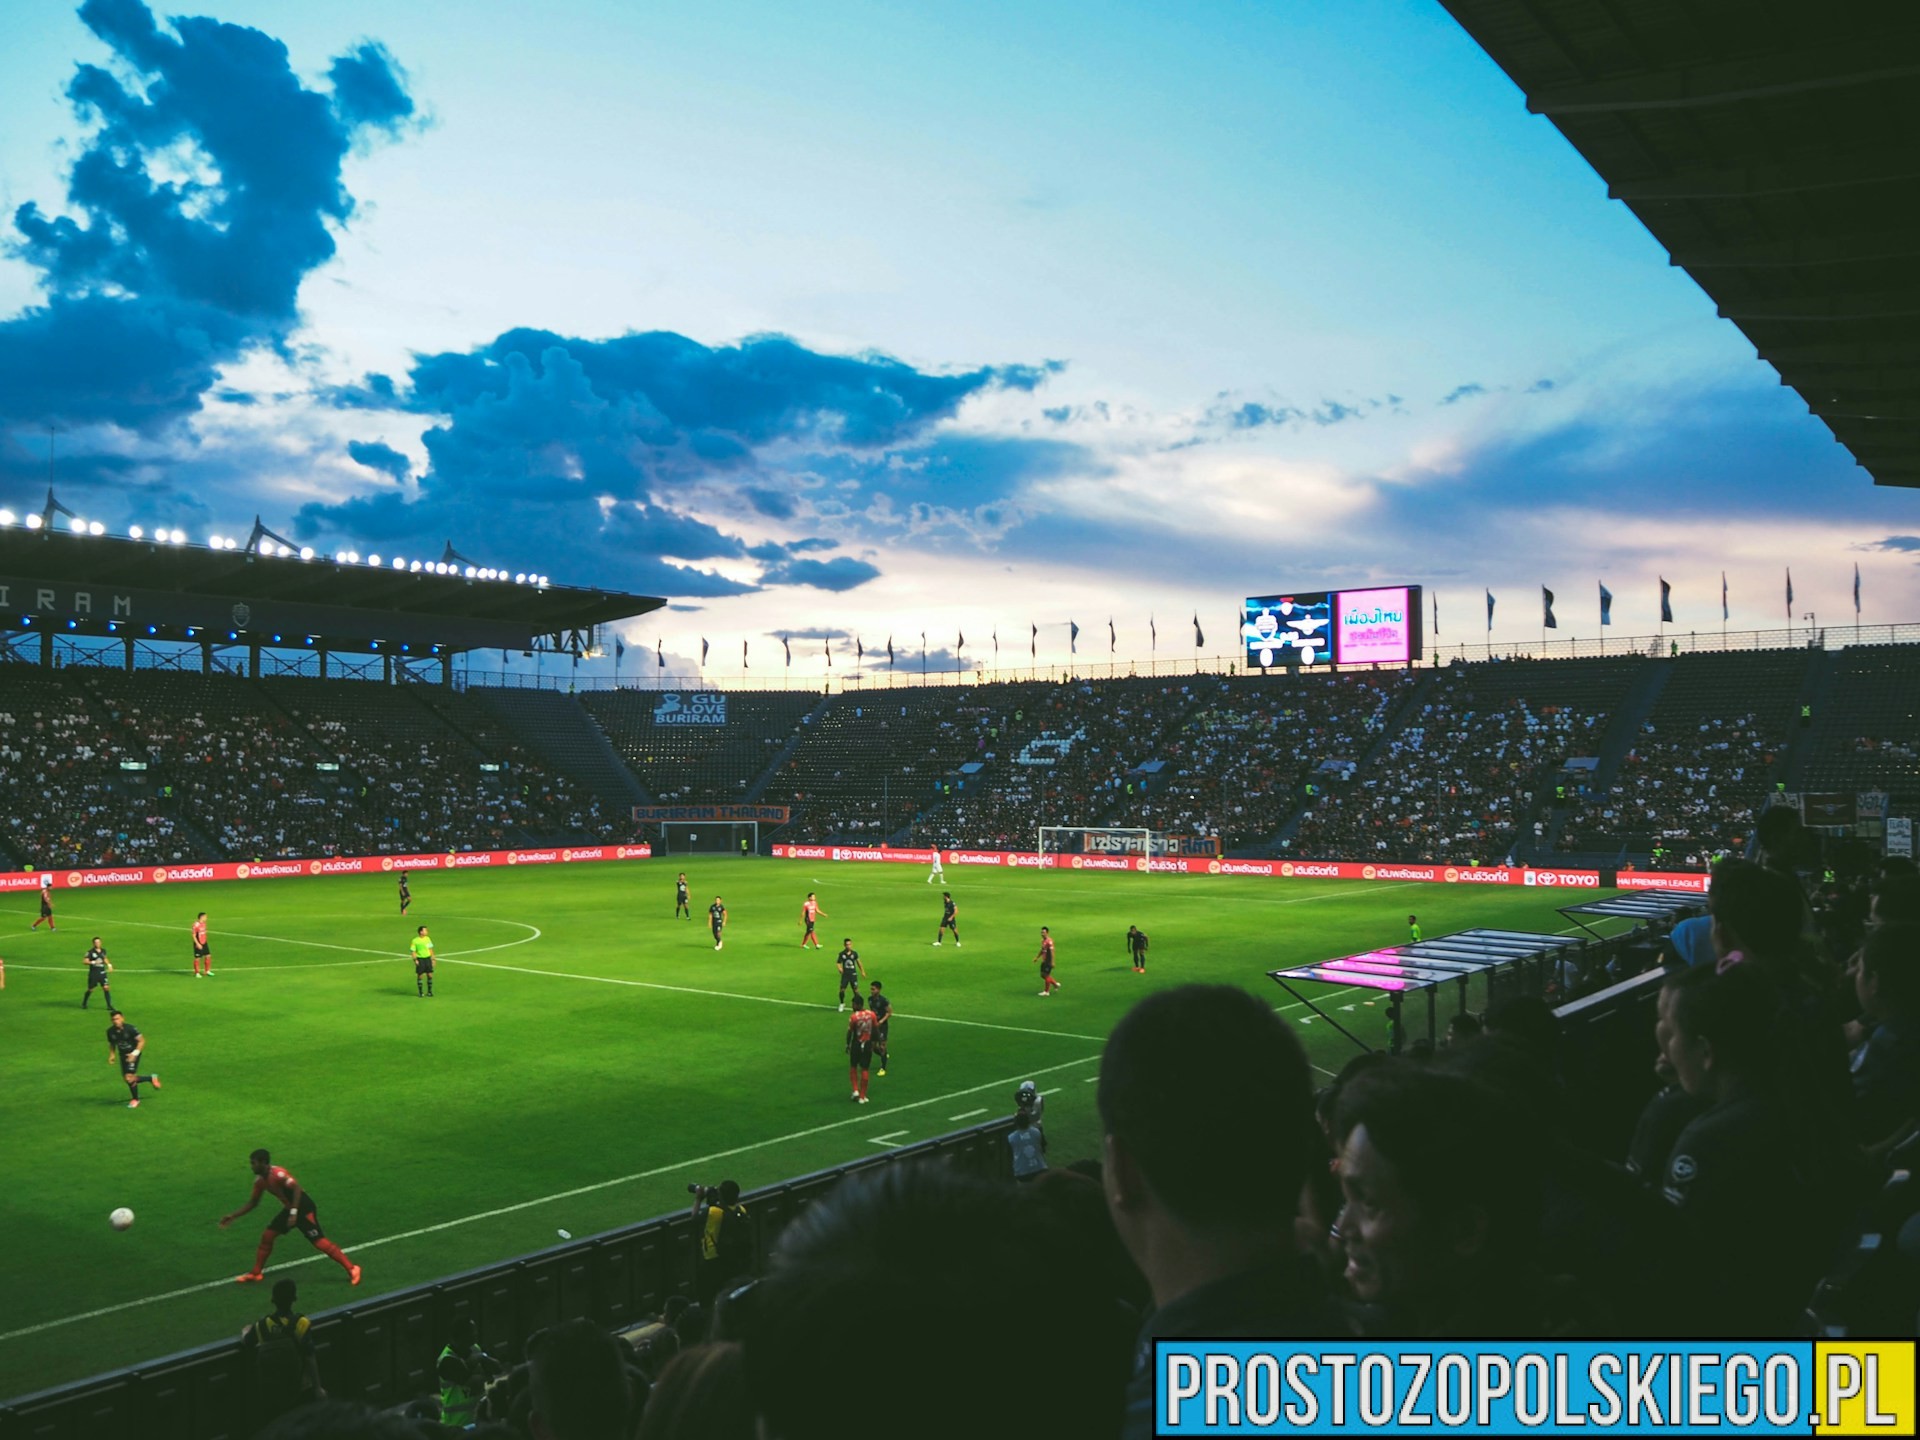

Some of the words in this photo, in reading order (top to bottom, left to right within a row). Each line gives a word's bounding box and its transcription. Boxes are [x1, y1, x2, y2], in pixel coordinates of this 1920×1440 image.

[692, 694, 726, 704] GU
[683, 704, 726, 714] LOVE
[656, 714, 725, 723] BURIRAM
[637, 806, 715, 819] BURIRAM
[719, 806, 784, 819] THAILAND
[852, 850, 883, 860] TOYOTA
[8, 877, 38, 886] LEAGUE
[1631, 877, 1668, 887] PREMIER
[1669, 879, 1701, 888] LEAGUE
